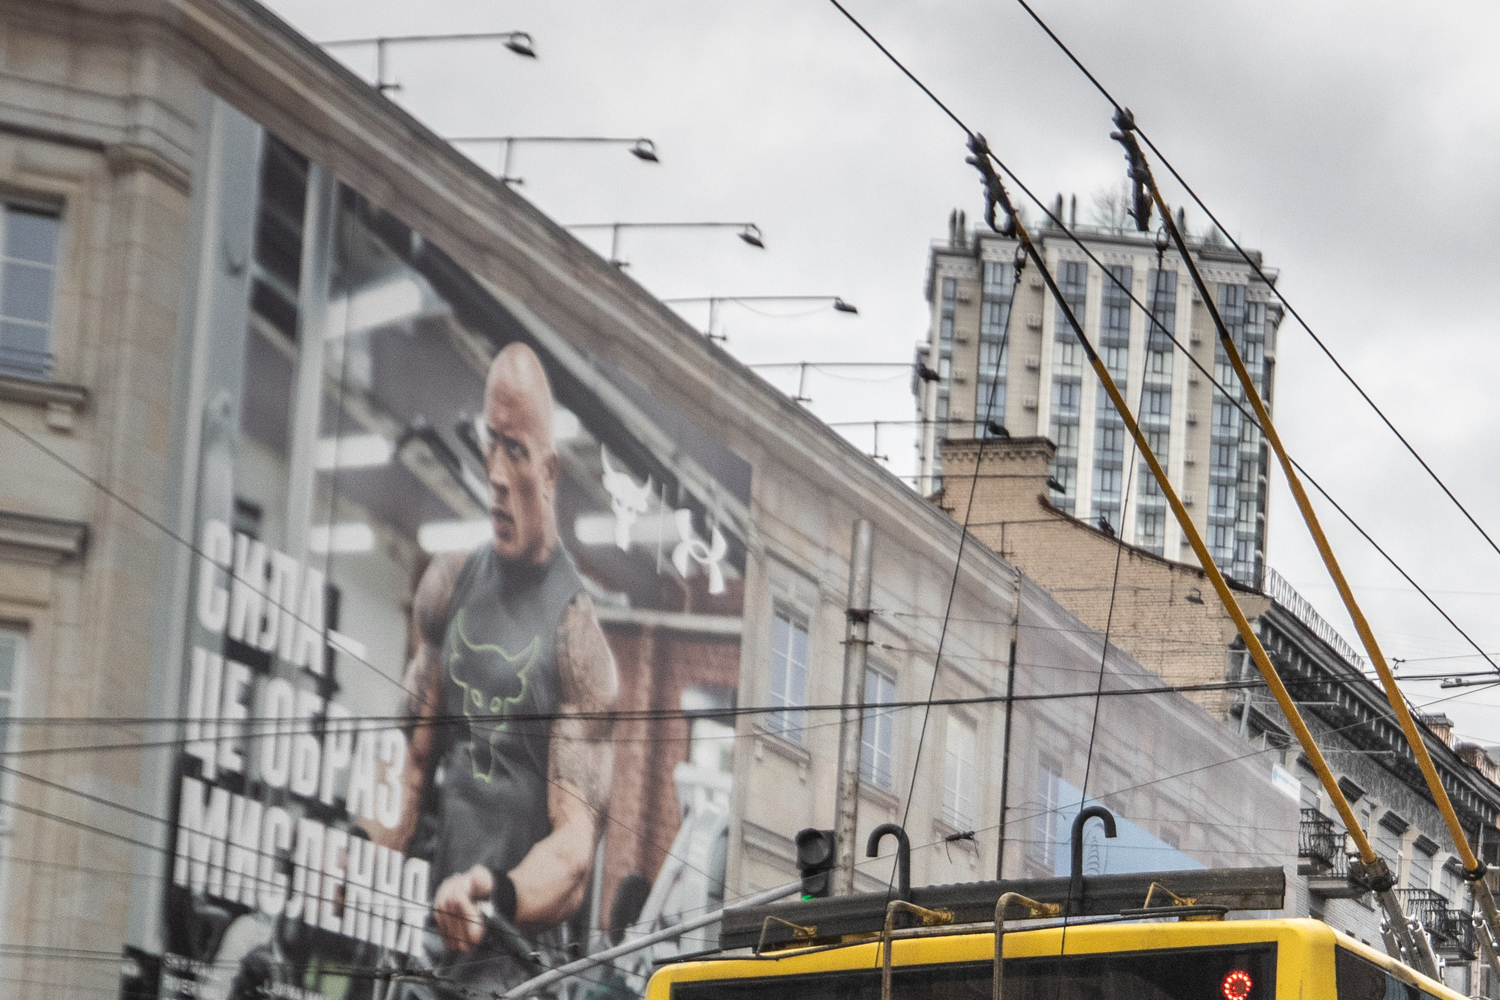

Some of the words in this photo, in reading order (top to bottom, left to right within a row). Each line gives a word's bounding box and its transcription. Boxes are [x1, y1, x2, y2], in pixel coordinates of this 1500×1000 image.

[197, 519, 326, 676] СИЛА
[184, 645, 252, 781] ЦЕ
[260, 676, 409, 829] ОБРАЗ
[173, 775, 431, 956] МИСЛЕННЯ
